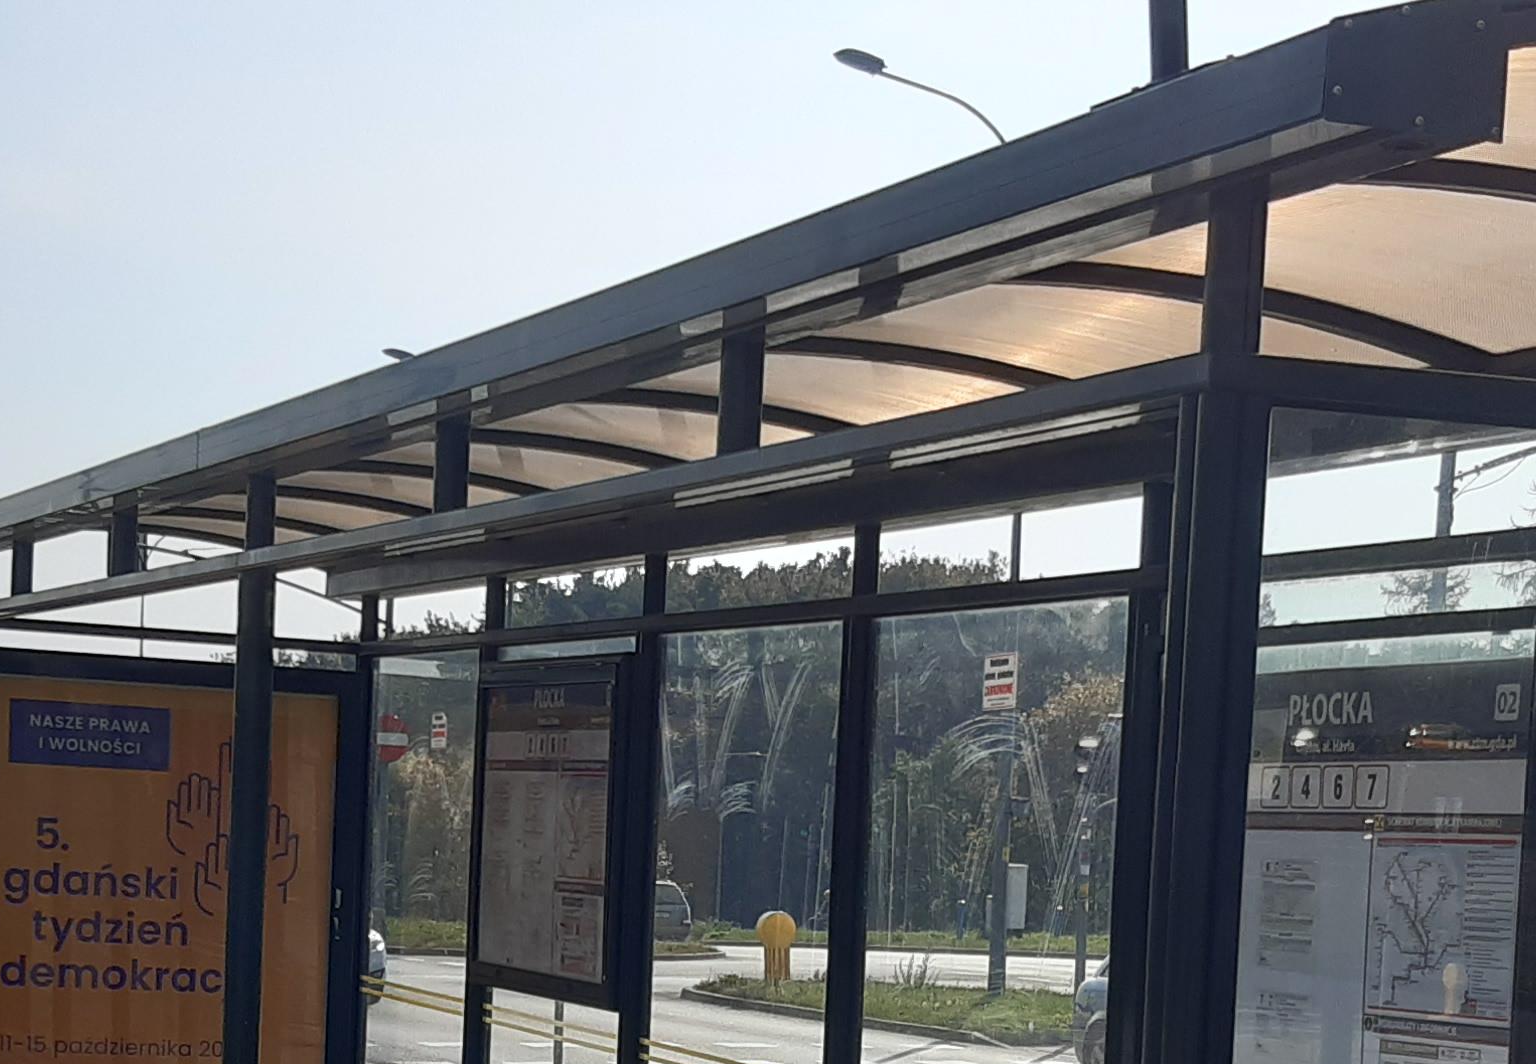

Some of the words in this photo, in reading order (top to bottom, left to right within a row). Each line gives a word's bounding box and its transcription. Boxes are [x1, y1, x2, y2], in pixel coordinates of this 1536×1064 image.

[29, 713, 84, 731] NASZE
[89, 716, 151, 734] PRAWA
[1288, 691, 1373, 726] PŁOCKA
[1497, 691, 1519, 715] 02
[39, 737, 44, 752] I
[49, 734, 142, 756] WOLNOŚCI
[1271, 776, 1281, 800] 2
[1301, 775, 1311, 799] 4
[1333, 775, 1343, 800] 6
[1367, 773, 1377, 800] 7
[35, 817, 70, 851] 5.
[3, 862, 179, 903] gdański
[32, 910, 189, 952] tydzień
[0, 955, 223, 994] demokrac
[54, 1035, 192, 1059] października
[199, 1040, 224, 1059] 20
